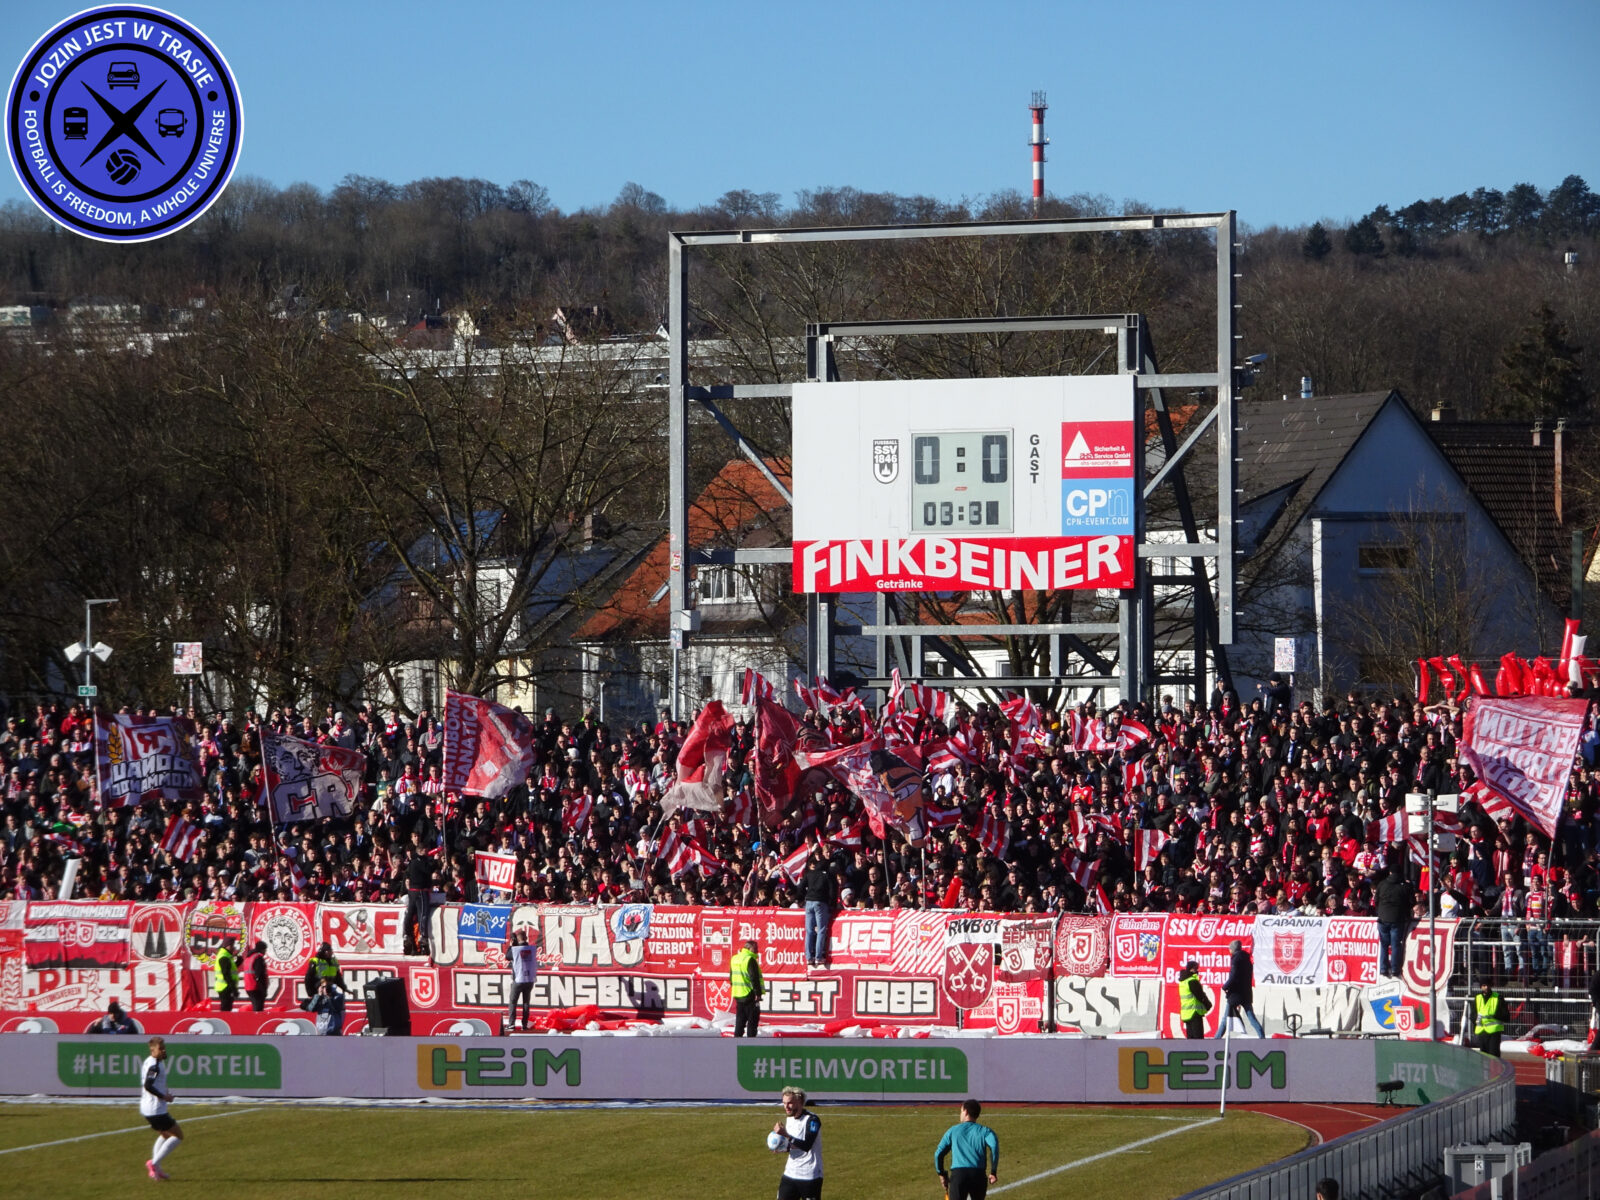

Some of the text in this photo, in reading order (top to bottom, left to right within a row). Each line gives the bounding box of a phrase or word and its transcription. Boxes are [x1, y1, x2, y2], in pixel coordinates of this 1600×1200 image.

[874, 446, 897, 454] SSV
[874, 455, 898, 463] 1846
[1029, 434, 1040, 484] GAST
[1066, 517, 1129, 526] CPN-EVENT.COM
[803, 535, 1122, 593] FINKBEINER
[876, 580, 923, 589] Getränke
[461, 912, 475, 927] BB
[650, 913, 697, 924] SEKTION
[1262, 918, 1323, 928] CAPANNA
[650, 926, 694, 939] STADION
[739, 922, 805, 944] Die Power
[1168, 919, 1199, 936] SSV
[1328, 921, 1379, 940] SEKTION
[648, 941, 694, 955] VERBOT
[1327, 942, 1379, 956] BAYERWALD
[765, 946, 805, 966] Tower
[1261, 973, 1318, 984] AMICIS
[1360, 962, 1377, 981] 25
[857, 980, 937, 1014] 1889
[753, 1057, 952, 1080] #HEIMVORTEIL
